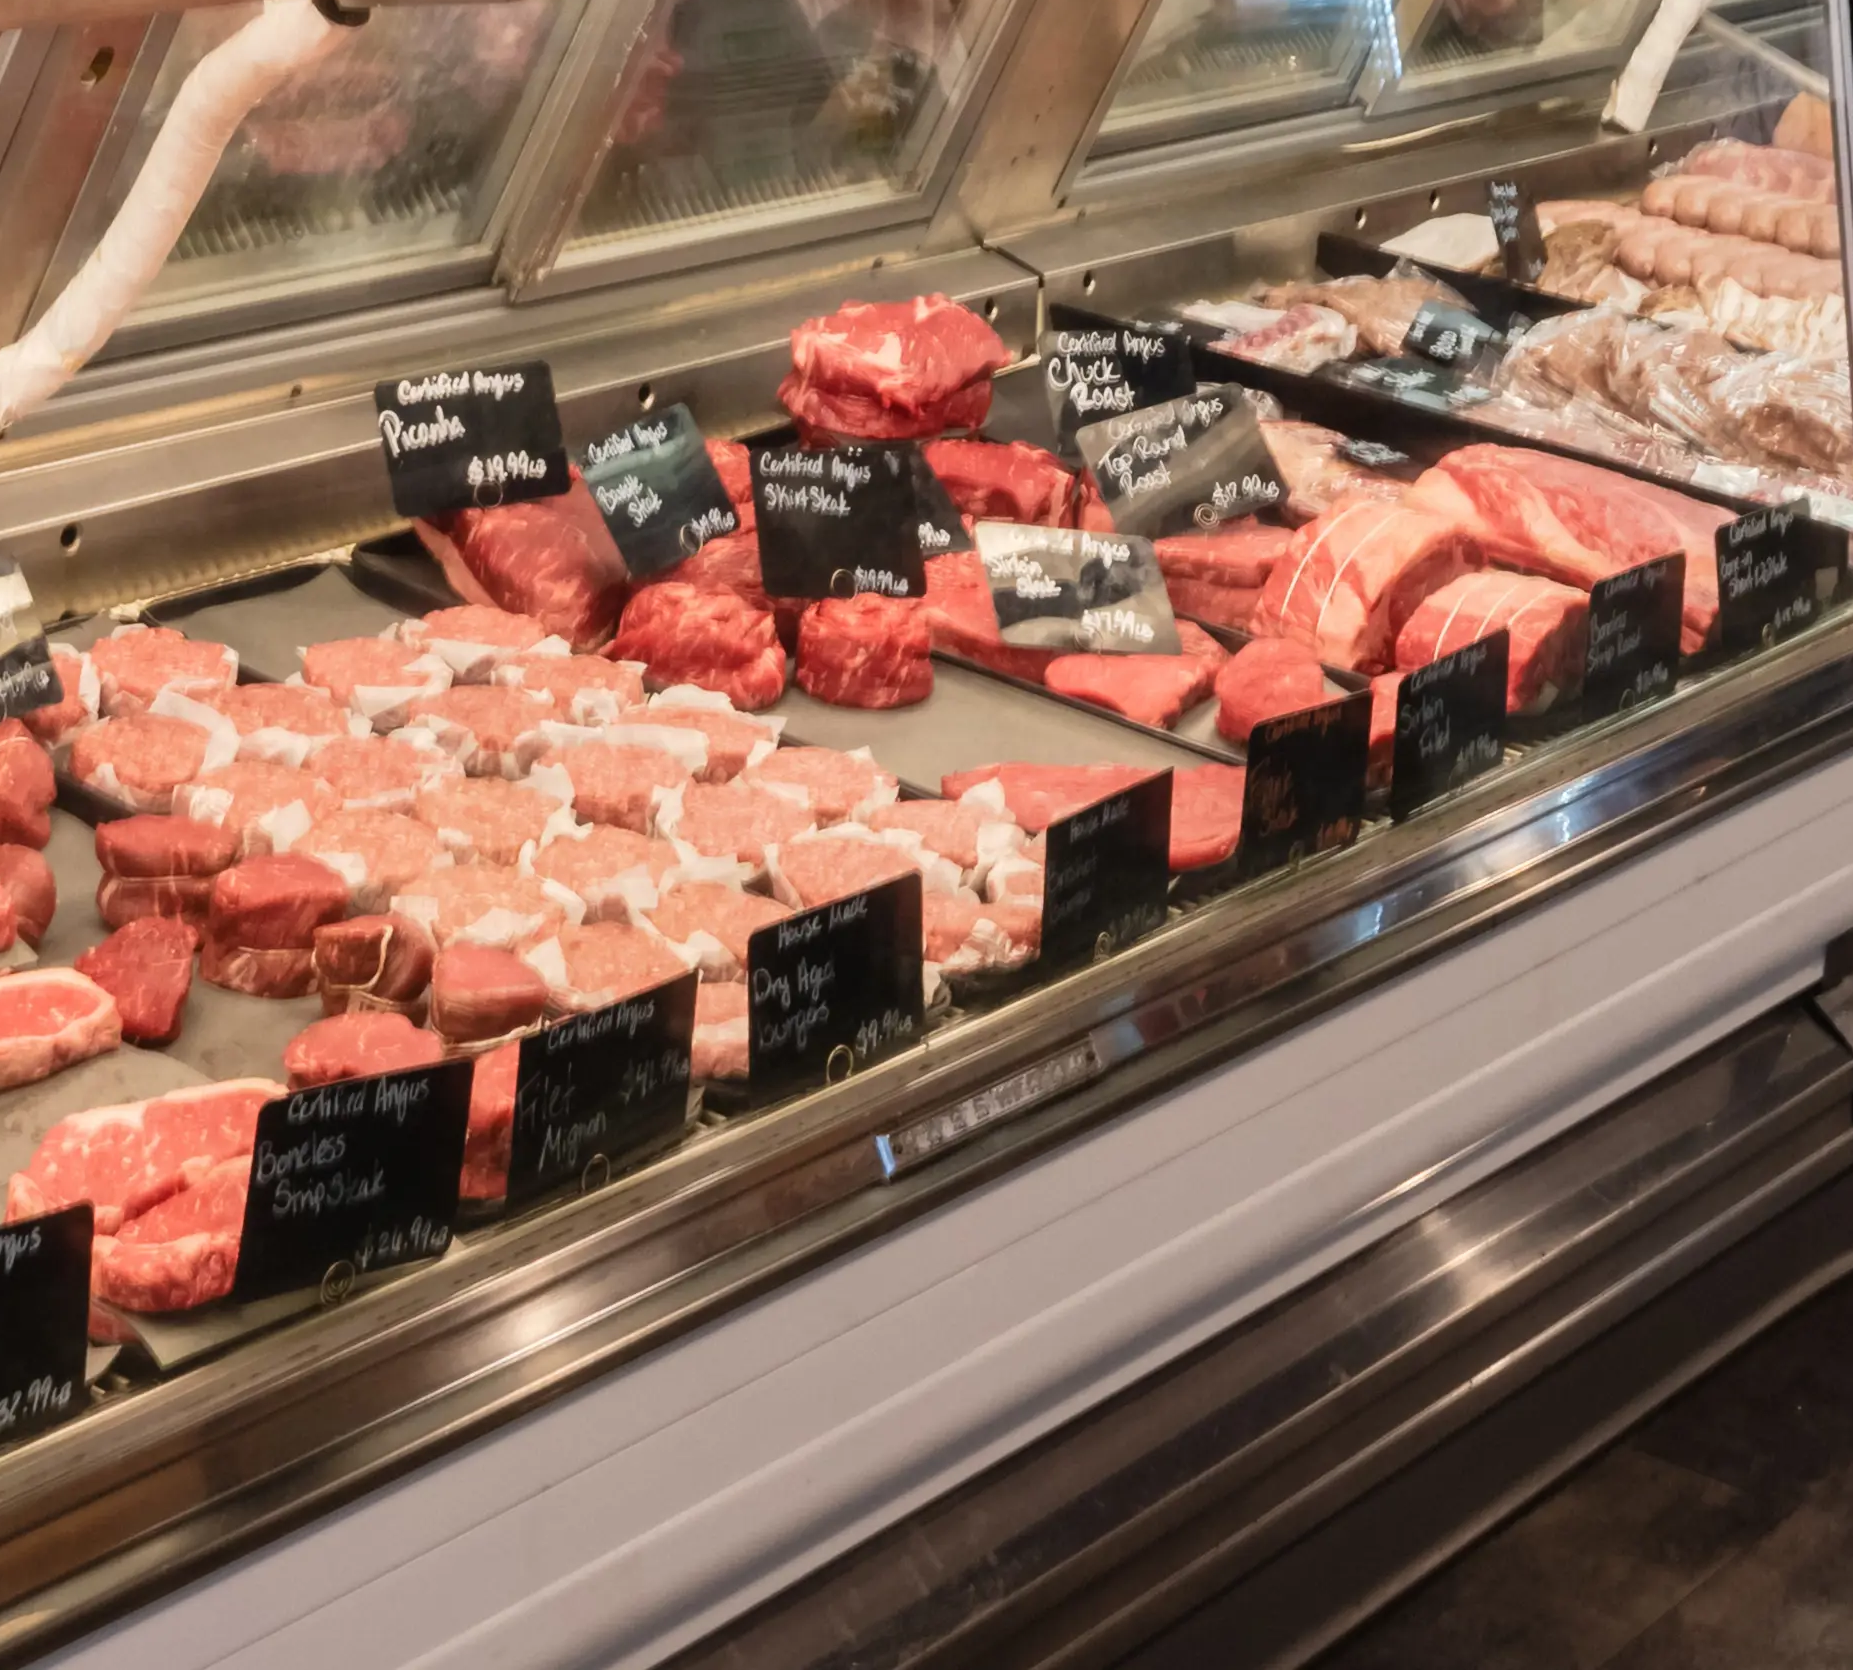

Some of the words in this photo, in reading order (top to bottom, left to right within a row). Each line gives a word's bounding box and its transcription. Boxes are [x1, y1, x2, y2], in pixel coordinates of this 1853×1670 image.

[1124, 332, 1165, 363] Angus
[397, 372, 471, 406] Certified
[474, 370, 524, 397] Angus
[1049, 357, 1121, 392] Chuck
[1070, 384, 1135, 414] Roast
[760, 453, 824, 478] Certified
[831, 451, 871, 484] Angus
[256, 1131, 345, 1183] Boneless
